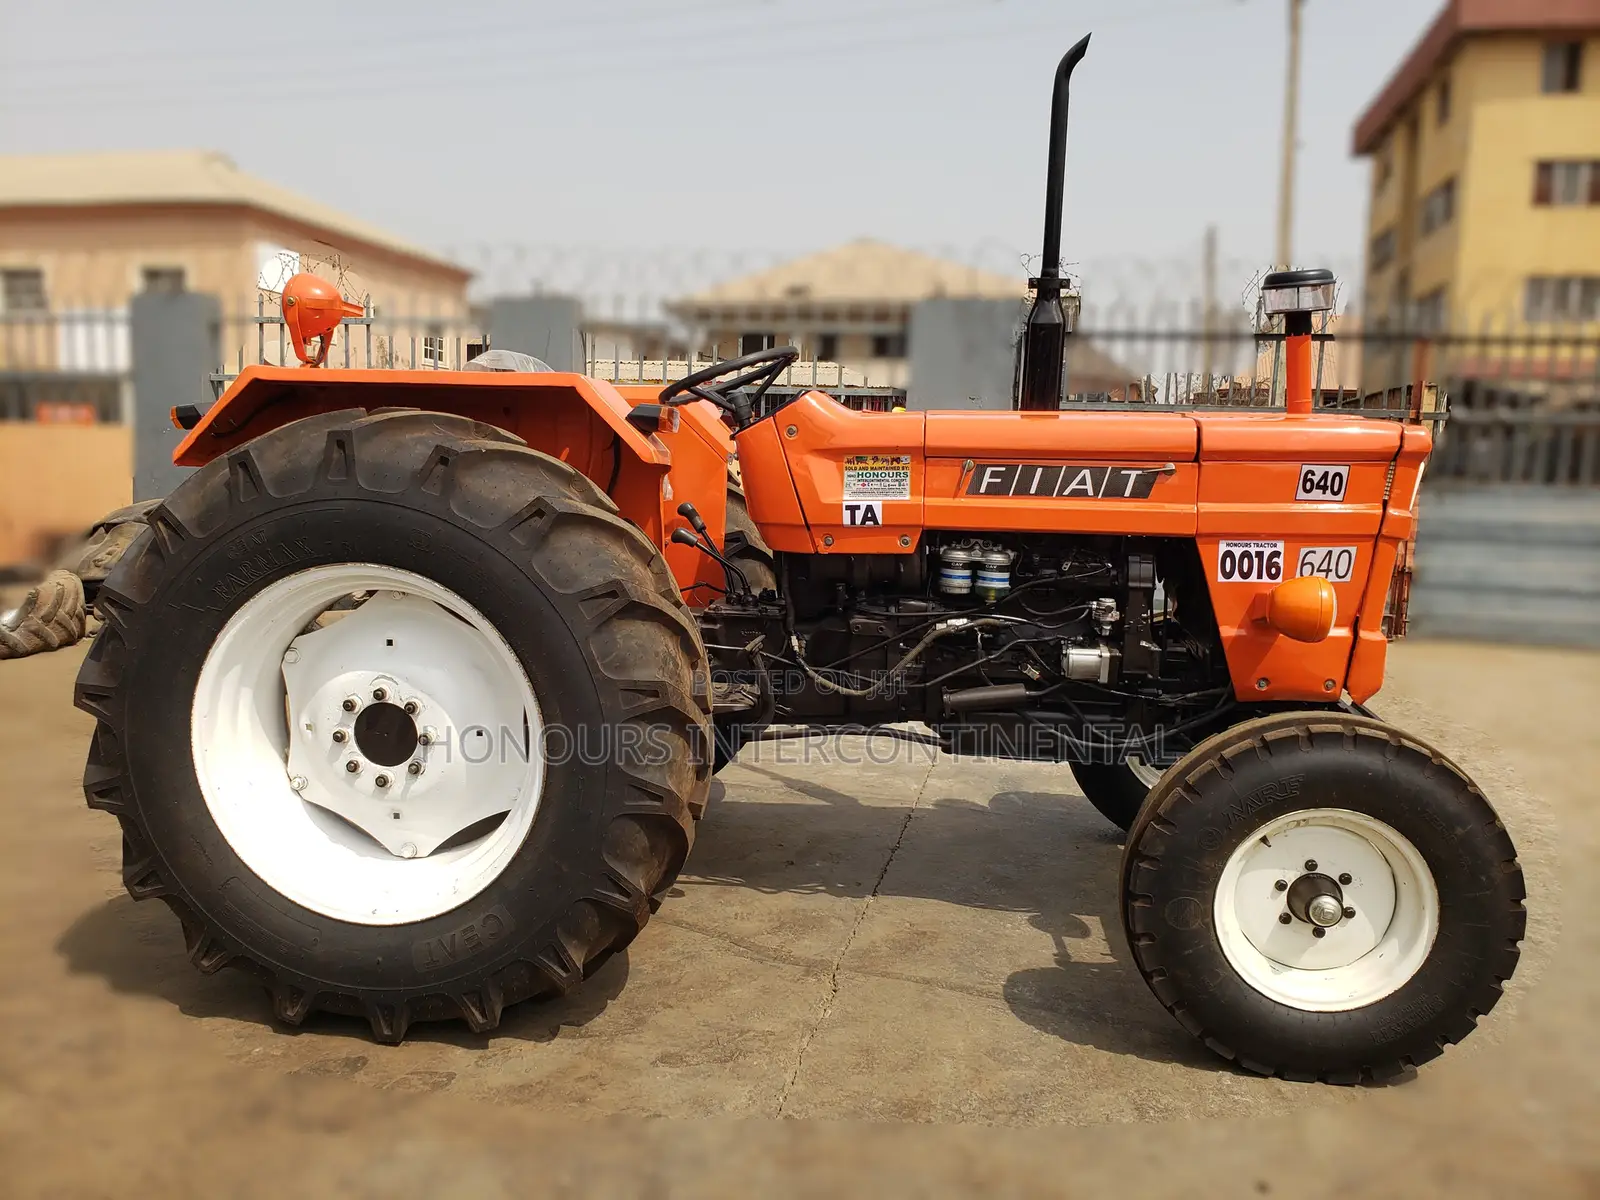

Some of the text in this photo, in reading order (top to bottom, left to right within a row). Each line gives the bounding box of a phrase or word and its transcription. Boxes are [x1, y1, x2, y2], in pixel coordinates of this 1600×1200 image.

[979, 467, 1148, 497] FIAT
[1301, 469, 1344, 496] 640
[845, 504, 880, 526] TA
[1220, 549, 1282, 581] 0016
[1299, 549, 1353, 580] 640
[422, 913, 504, 968] CEAT
